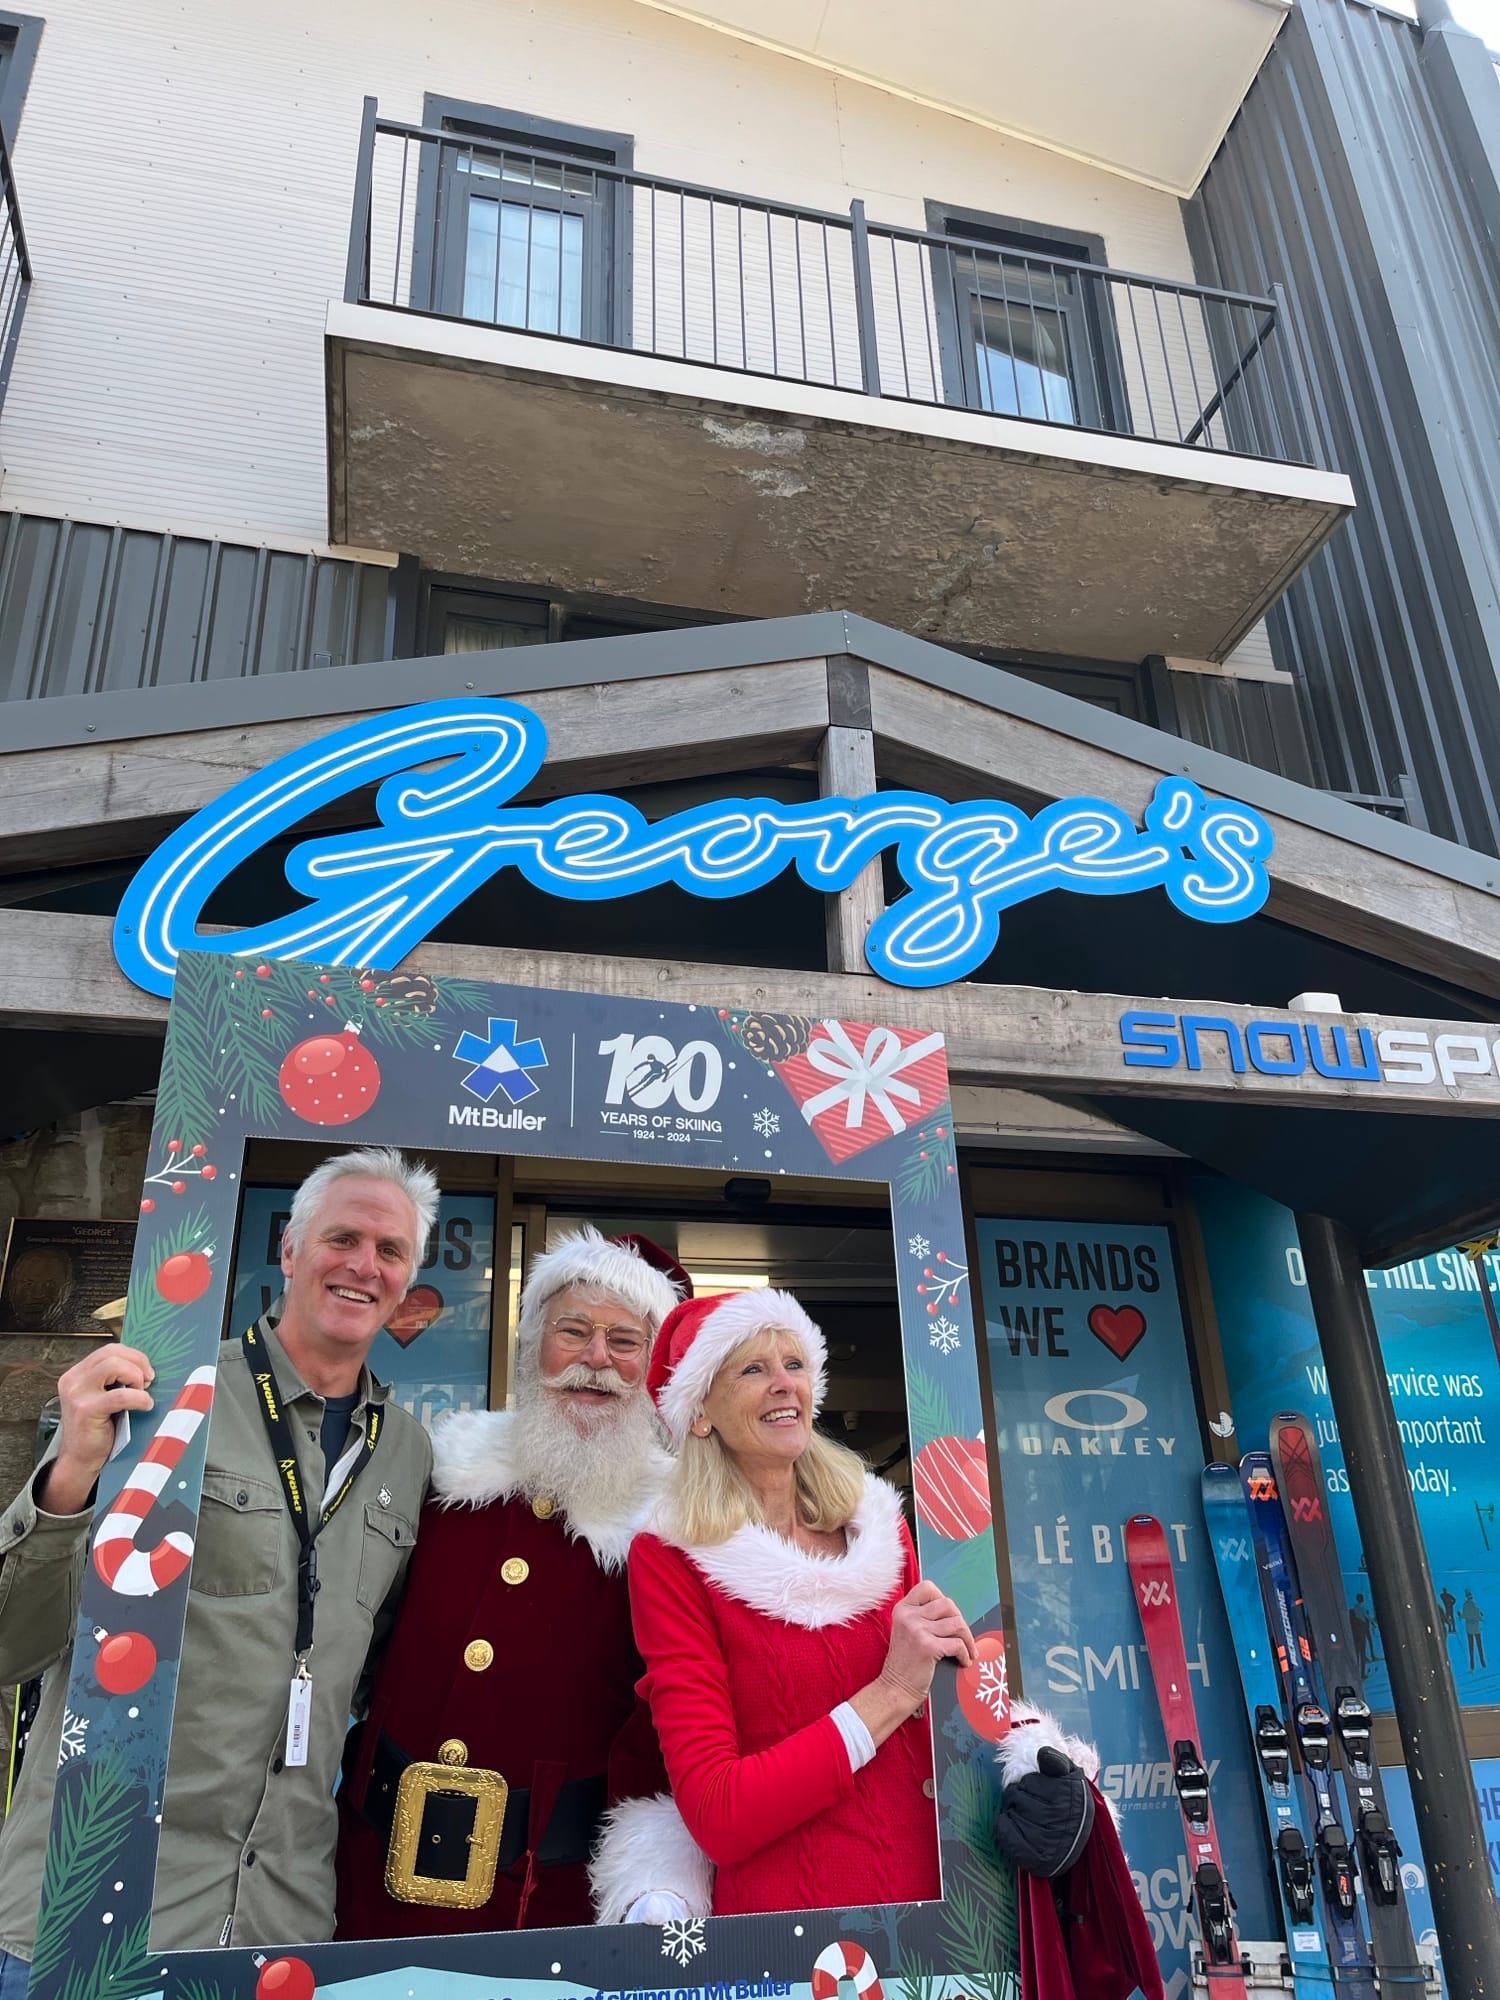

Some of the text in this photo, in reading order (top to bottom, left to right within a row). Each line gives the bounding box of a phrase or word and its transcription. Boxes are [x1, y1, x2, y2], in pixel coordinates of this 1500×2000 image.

[114, 697, 1276, 990] George's
[598, 1032, 722, 1113] 100
[600, 1111, 722, 1133] YEARS OF SKIING
[633, 1130, 656, 1140] 1924
[667, 1132, 691, 1143] 2024
[995, 1240, 1160, 1293] BRANDS
[999, 1305, 1069, 1357] WE
[1386, 1367, 1483, 1398] ervice was
[1022, 1437, 1176, 1456] OAKLEY
[1397, 1415, 1486, 1448] mportant
[1408, 1462, 1457, 1496] oday.
[1034, 1514, 1073, 1565] LÉ
[1102, 1759, 1221, 1800] SWAY
[674, 1987, 701, 2000] on
[704, 1981, 731, 2000] Mt
[735, 1976, 794, 2000] Buller
